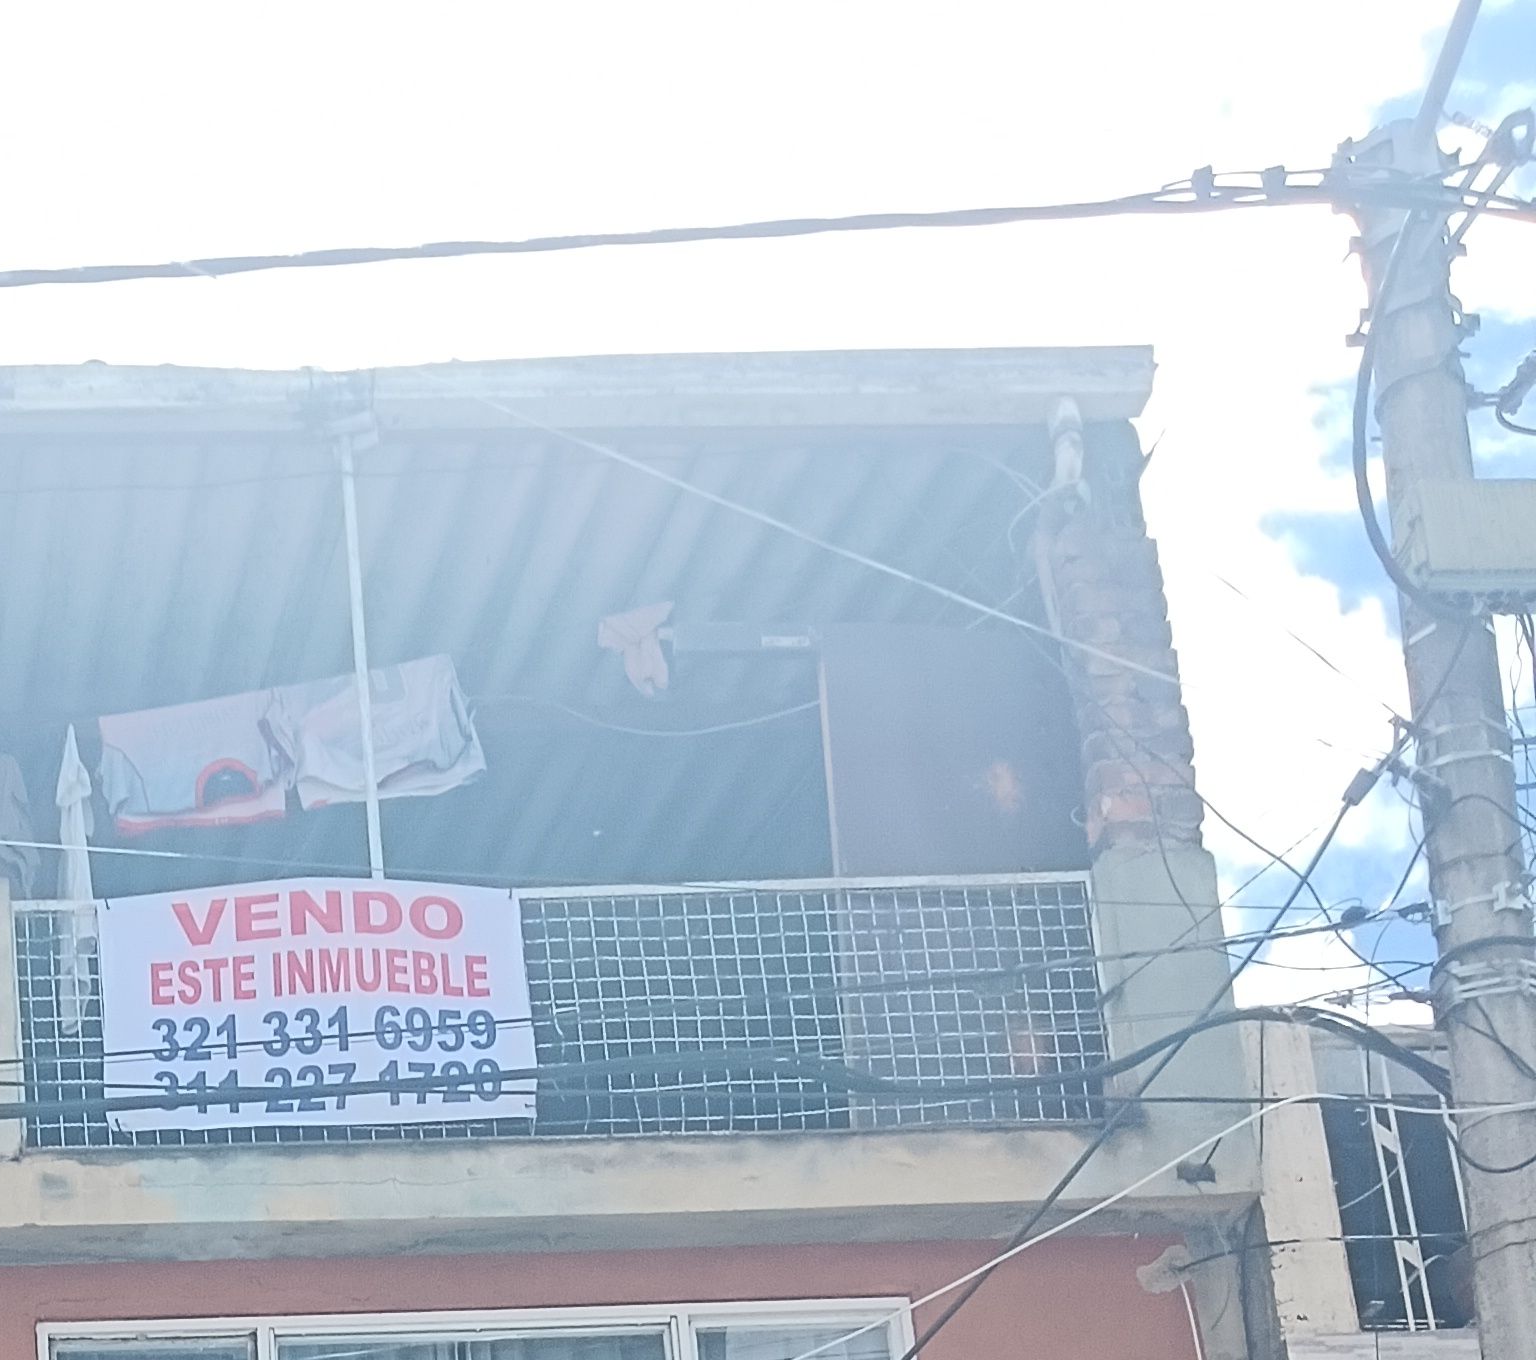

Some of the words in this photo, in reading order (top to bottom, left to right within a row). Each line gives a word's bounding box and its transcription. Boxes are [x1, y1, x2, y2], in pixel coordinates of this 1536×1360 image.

[171, 890, 464, 946] VENDO
[150, 954, 257, 1005] ESTE
[272, 947, 491, 998] INMUEBLE
[151, 1013, 239, 1062] 321
[262, 1005, 350, 1057] 331
[374, 1004, 497, 1053] 6959
